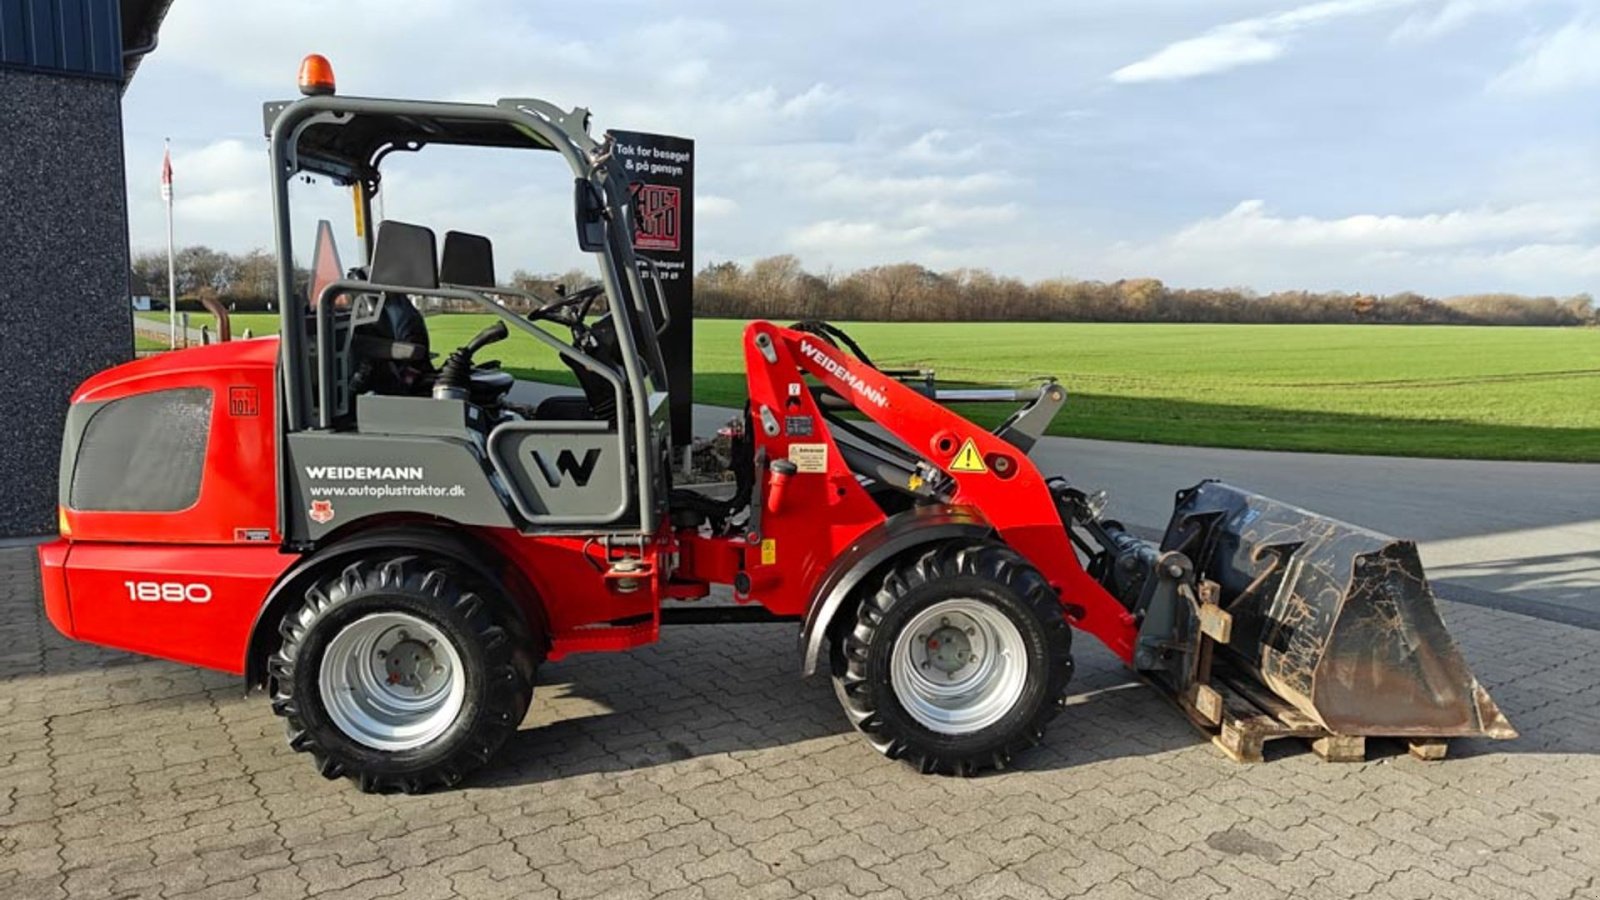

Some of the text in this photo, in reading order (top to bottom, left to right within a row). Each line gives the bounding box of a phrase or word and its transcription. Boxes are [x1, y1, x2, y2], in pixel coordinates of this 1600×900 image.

[616, 143, 635, 155] Tak
[636, 145, 652, 157] for
[625, 159, 634, 170] &
[800, 340, 888, 408] WEIDEMANN
[305, 466, 423, 480] WEIDEMANN
[310, 485, 465, 498] www.autoplustraktor.dk
[124, 581, 212, 603] 1880
